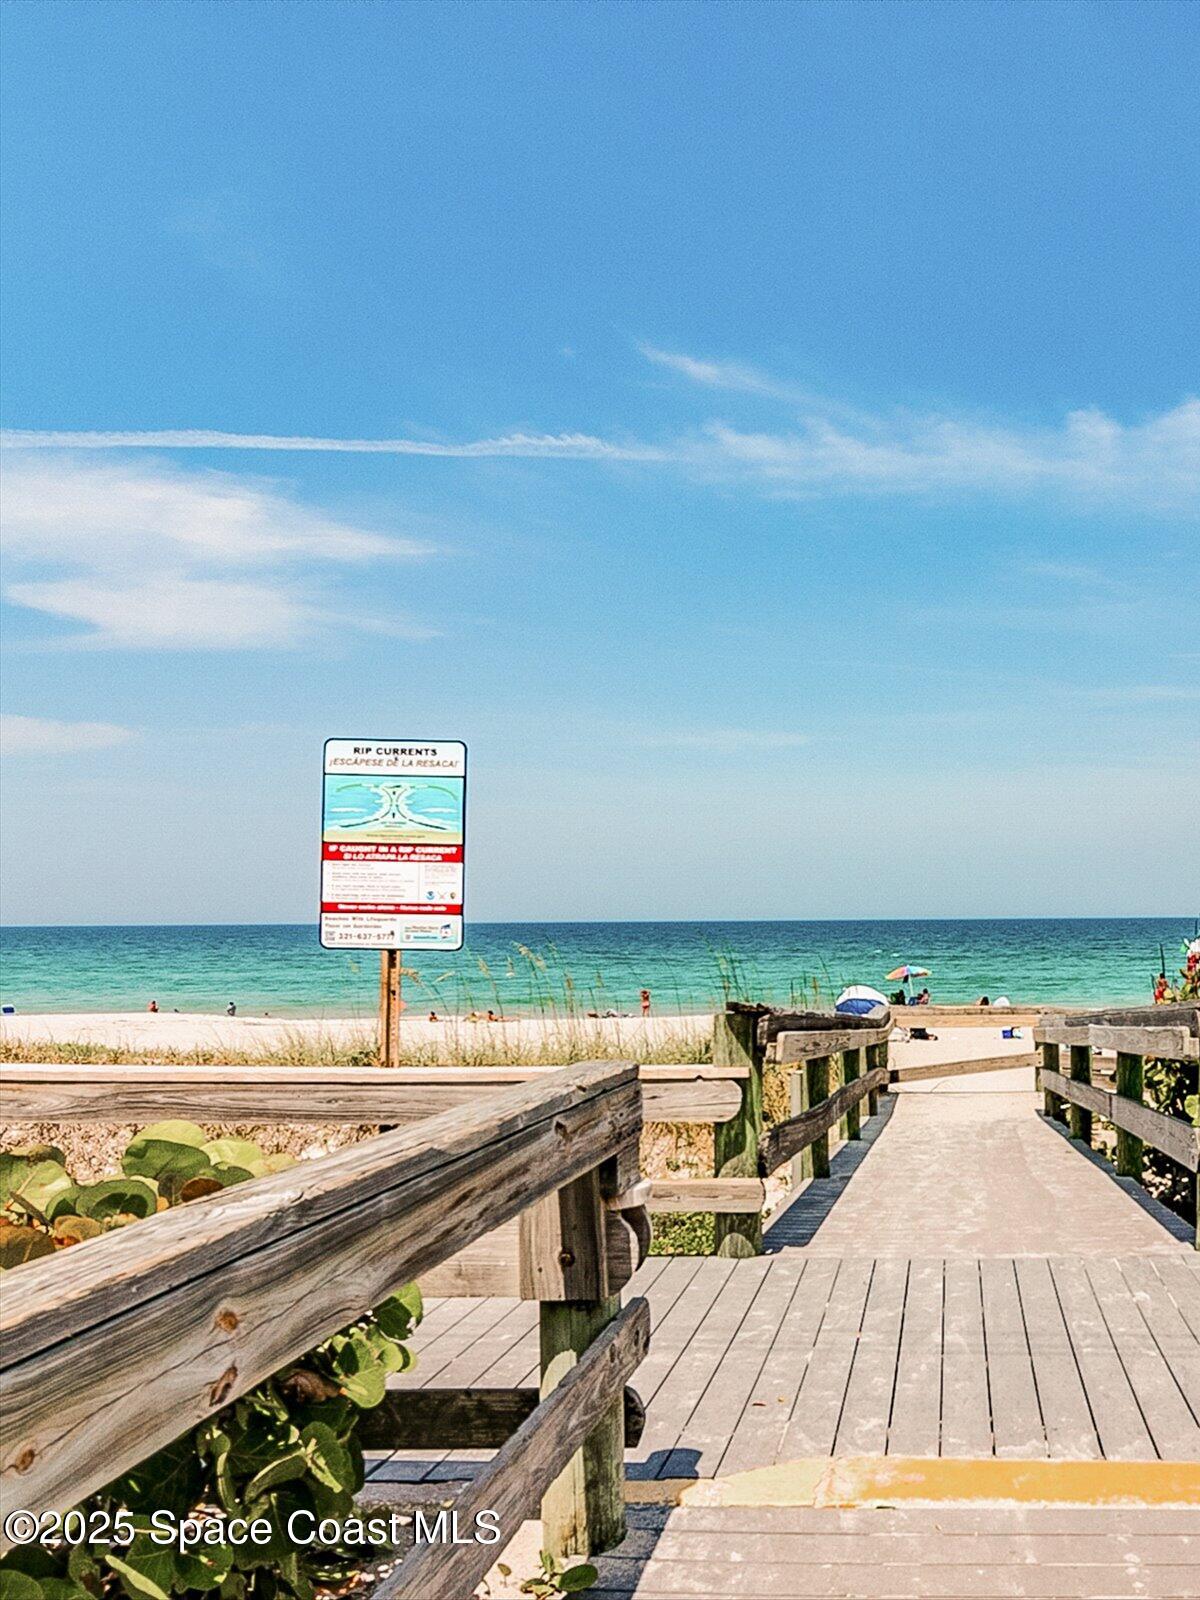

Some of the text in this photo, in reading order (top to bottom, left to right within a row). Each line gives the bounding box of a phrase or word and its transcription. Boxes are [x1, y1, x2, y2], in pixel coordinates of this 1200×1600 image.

[353, 747, 438, 756] RIP CURRENTS
[386, 759, 398, 767] DE
